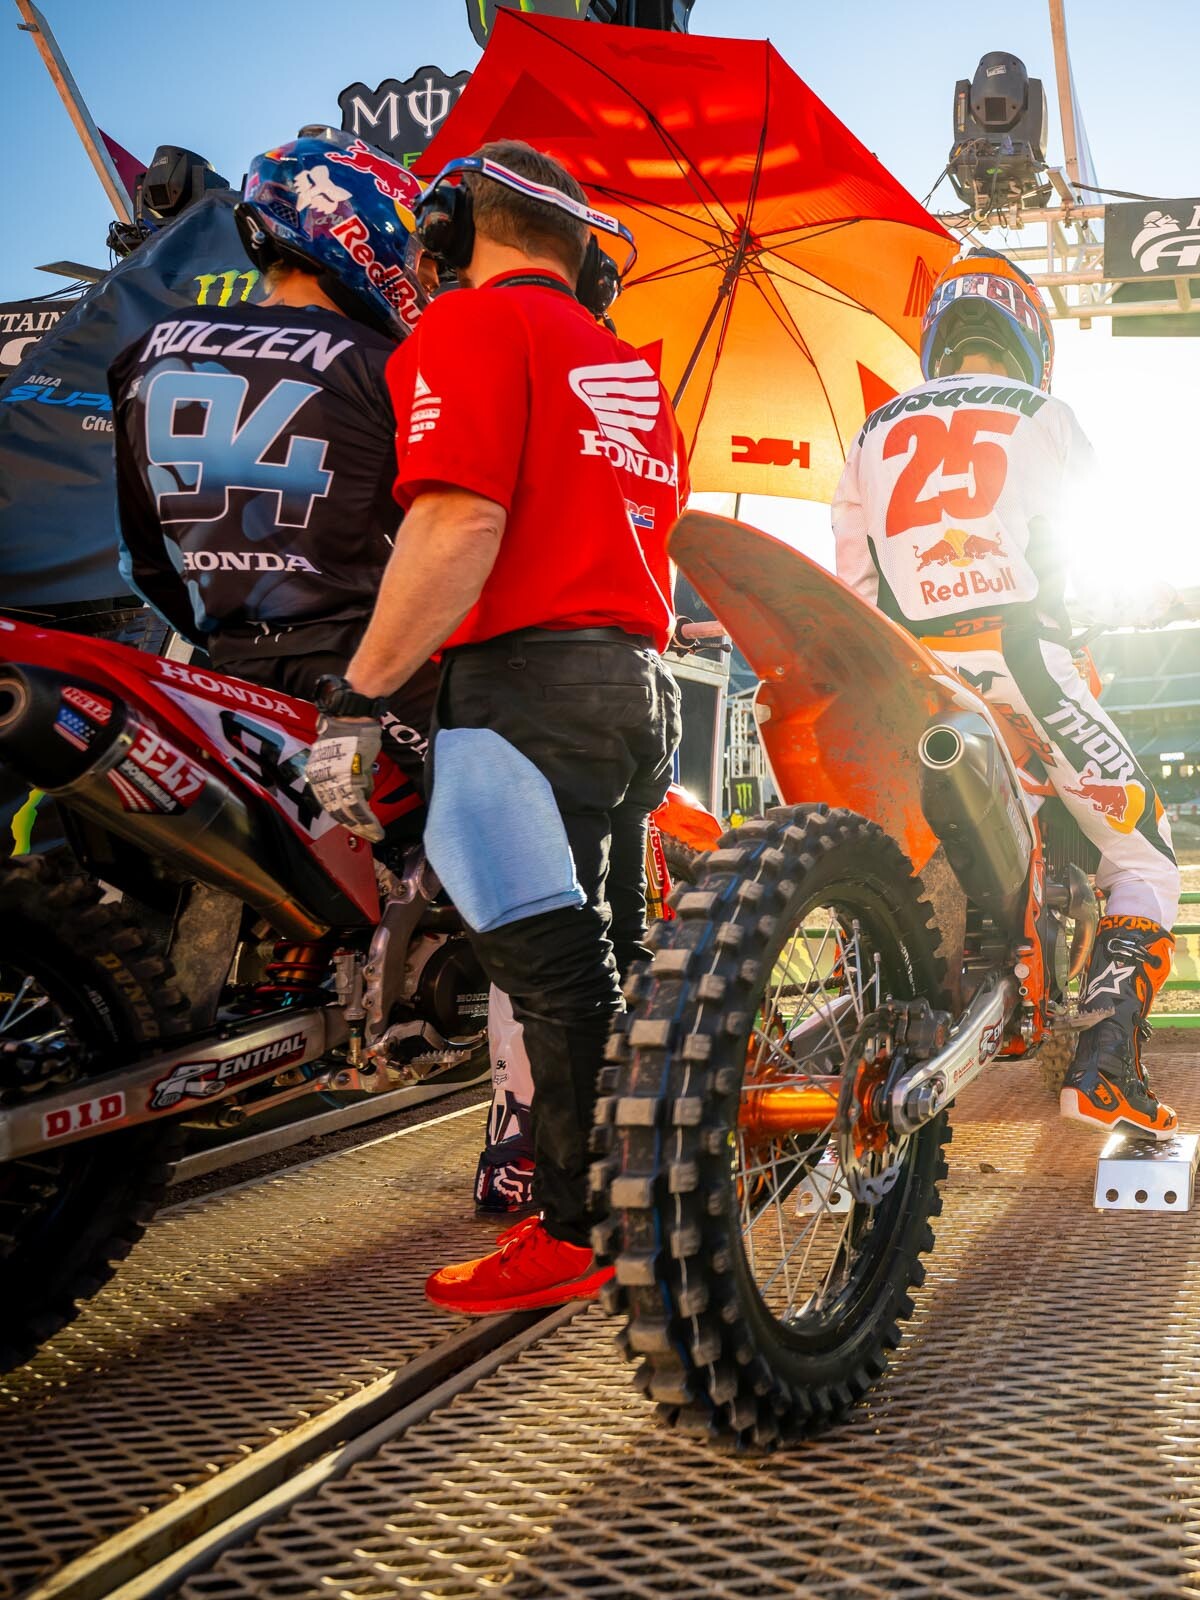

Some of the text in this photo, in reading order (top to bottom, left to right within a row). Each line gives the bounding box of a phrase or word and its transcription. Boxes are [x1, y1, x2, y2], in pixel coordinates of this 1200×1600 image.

[328, 213, 403, 296] Red
[138, 320, 356, 373] ROCZEN
[23, 375, 62, 387] AMA
[857, 385, 1048, 449] MUSQUIN
[145, 370, 336, 529] 94
[882, 408, 1021, 539] 25
[919, 566, 1017, 606] Red Bull
[155, 660, 302, 720] HONDA
[1042, 699, 1135, 781] THOR
[150, 1034, 305, 1108] RENTHAL
[46, 1094, 125, 1138] D.I.D
